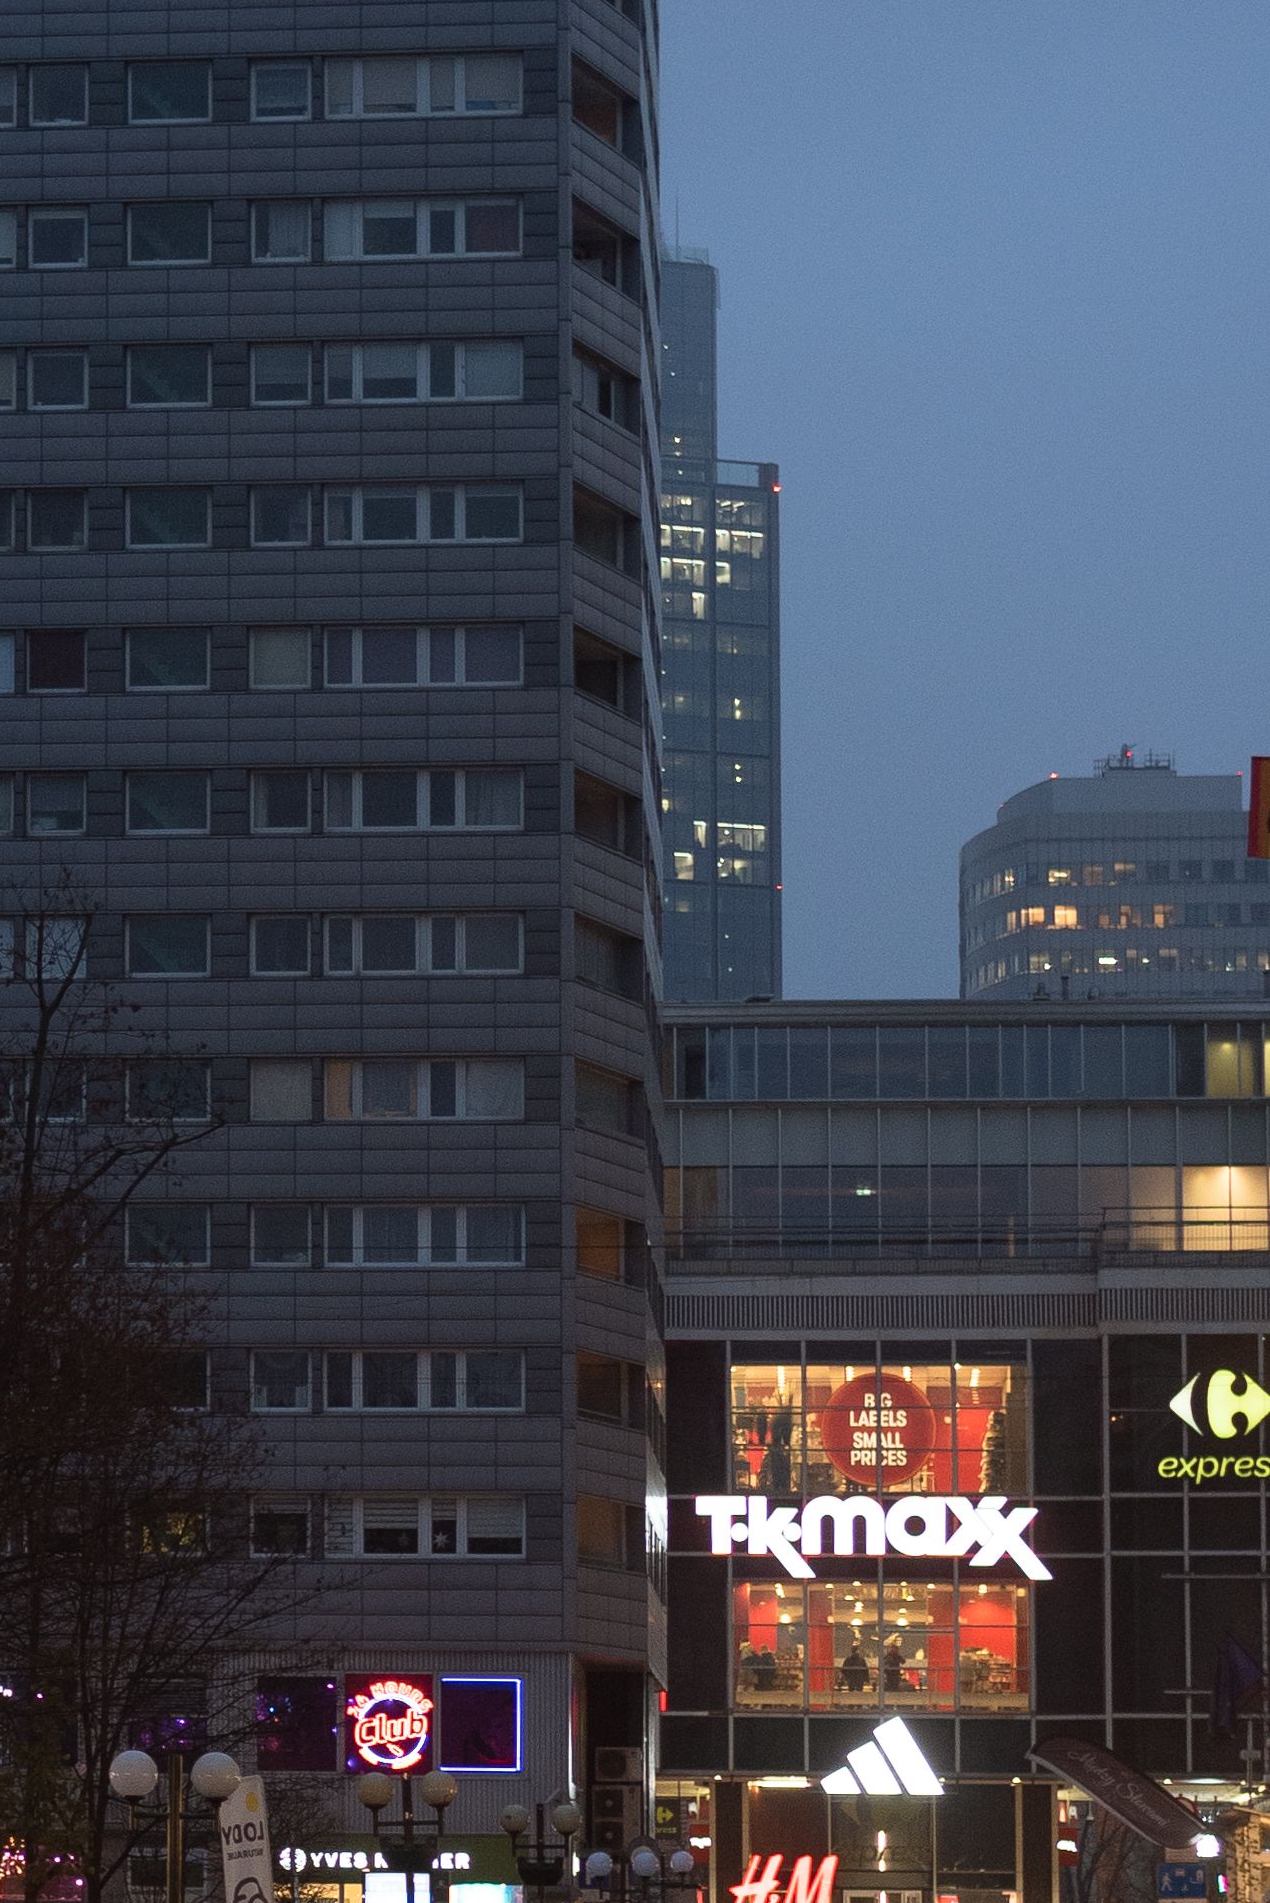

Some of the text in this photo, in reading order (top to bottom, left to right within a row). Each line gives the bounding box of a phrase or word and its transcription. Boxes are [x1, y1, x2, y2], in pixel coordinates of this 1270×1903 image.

[864, 1393, 892, 1407] BG
[849, 1410, 908, 1427] LABELS
[852, 1432, 904, 1448] SMALL
[311, 1851, 369, 1869] YVES
